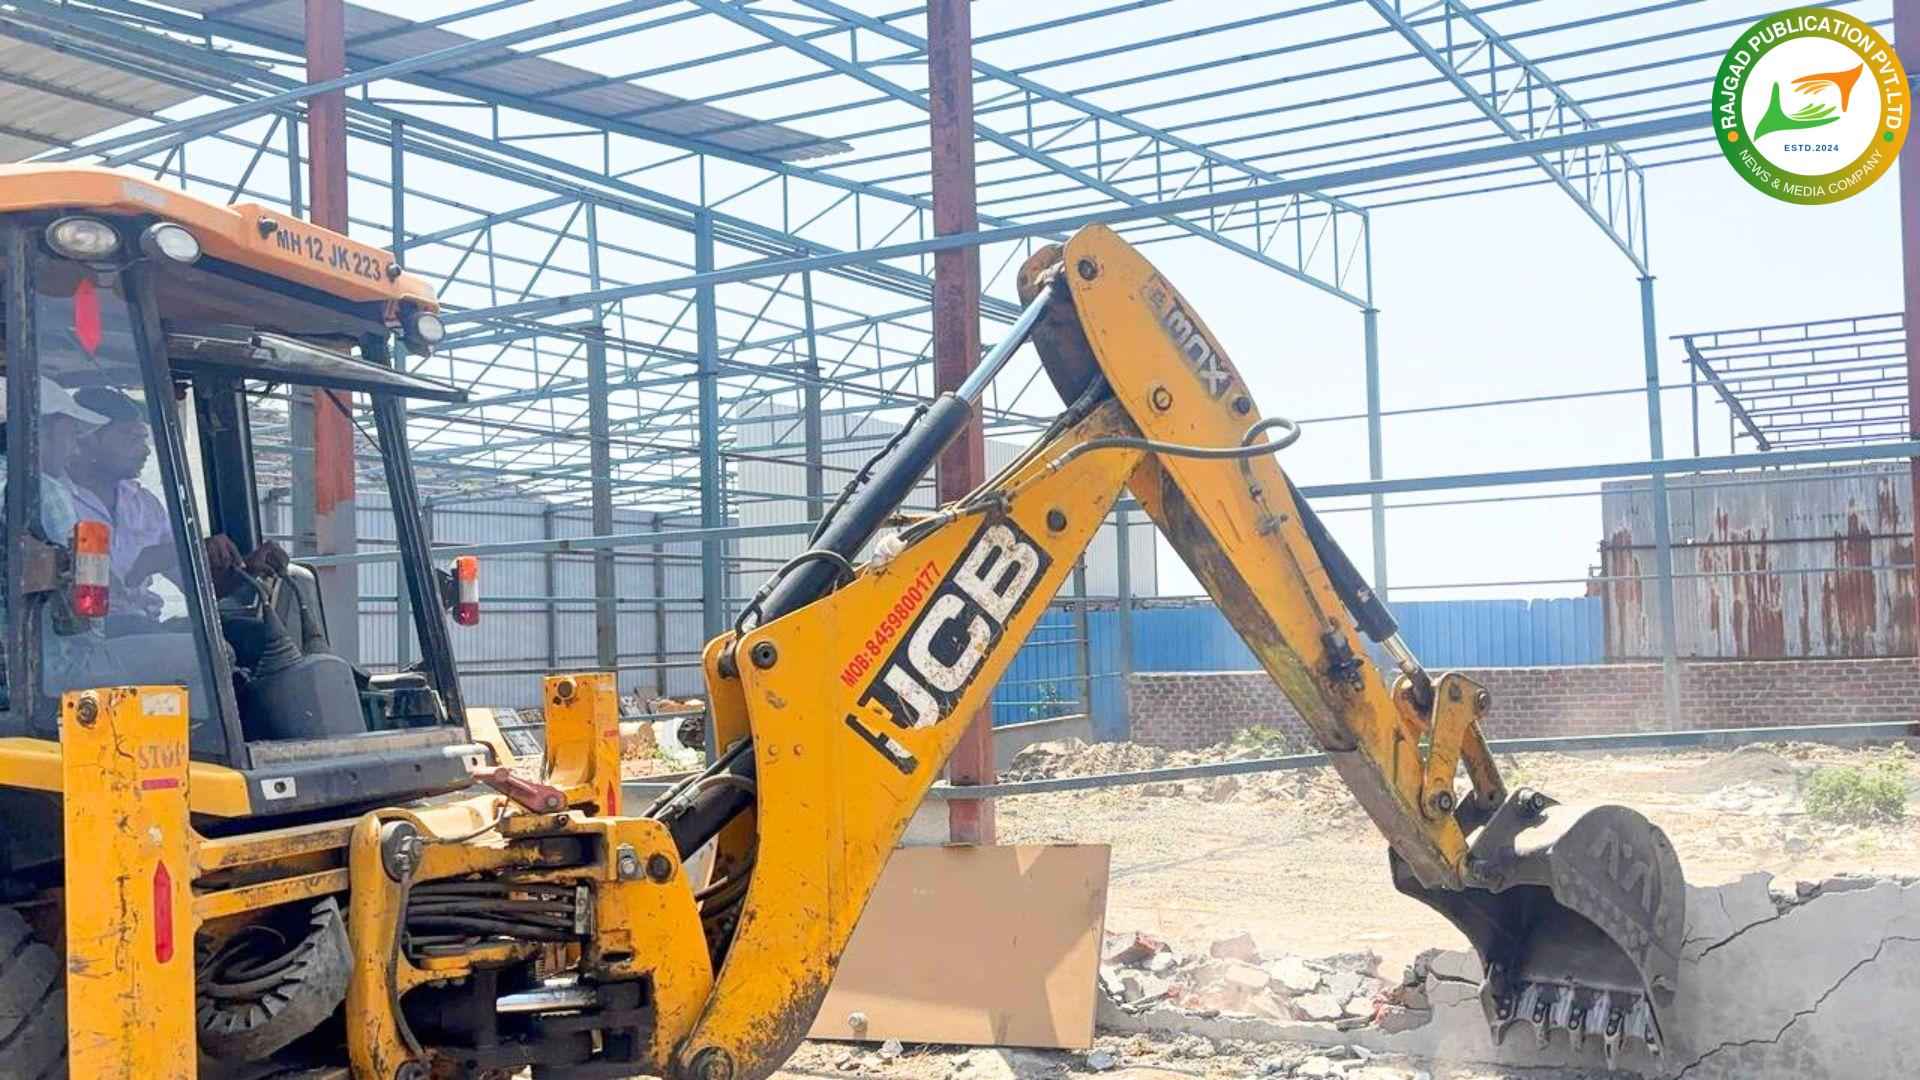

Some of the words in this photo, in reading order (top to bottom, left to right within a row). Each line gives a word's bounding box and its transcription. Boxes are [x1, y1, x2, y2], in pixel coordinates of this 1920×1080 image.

[276, 229, 302, 256] MH
[304, 234, 324, 263] 12
[329, 244, 350, 272] JK
[353, 252, 382, 281] 223
[1162, 308, 1229, 396] 3DX
[884, 523, 1039, 758] JCB
